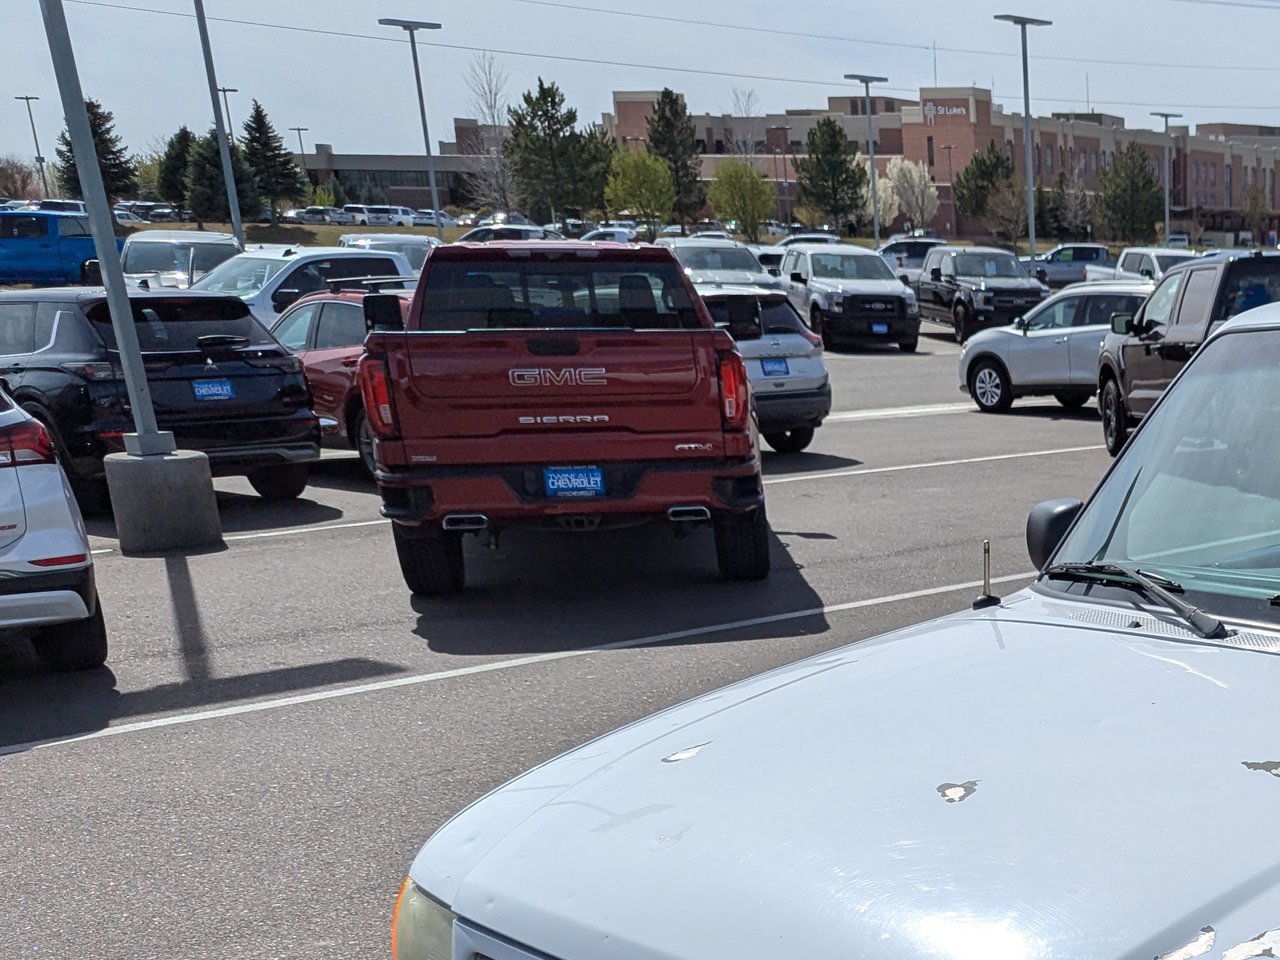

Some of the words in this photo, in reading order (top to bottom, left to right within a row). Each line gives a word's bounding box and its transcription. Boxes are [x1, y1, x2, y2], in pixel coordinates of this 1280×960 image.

[508, 367, 608, 386] GMC
[518, 415, 610, 424] SIERRA
[548, 478, 602, 489] CHEVROLET
